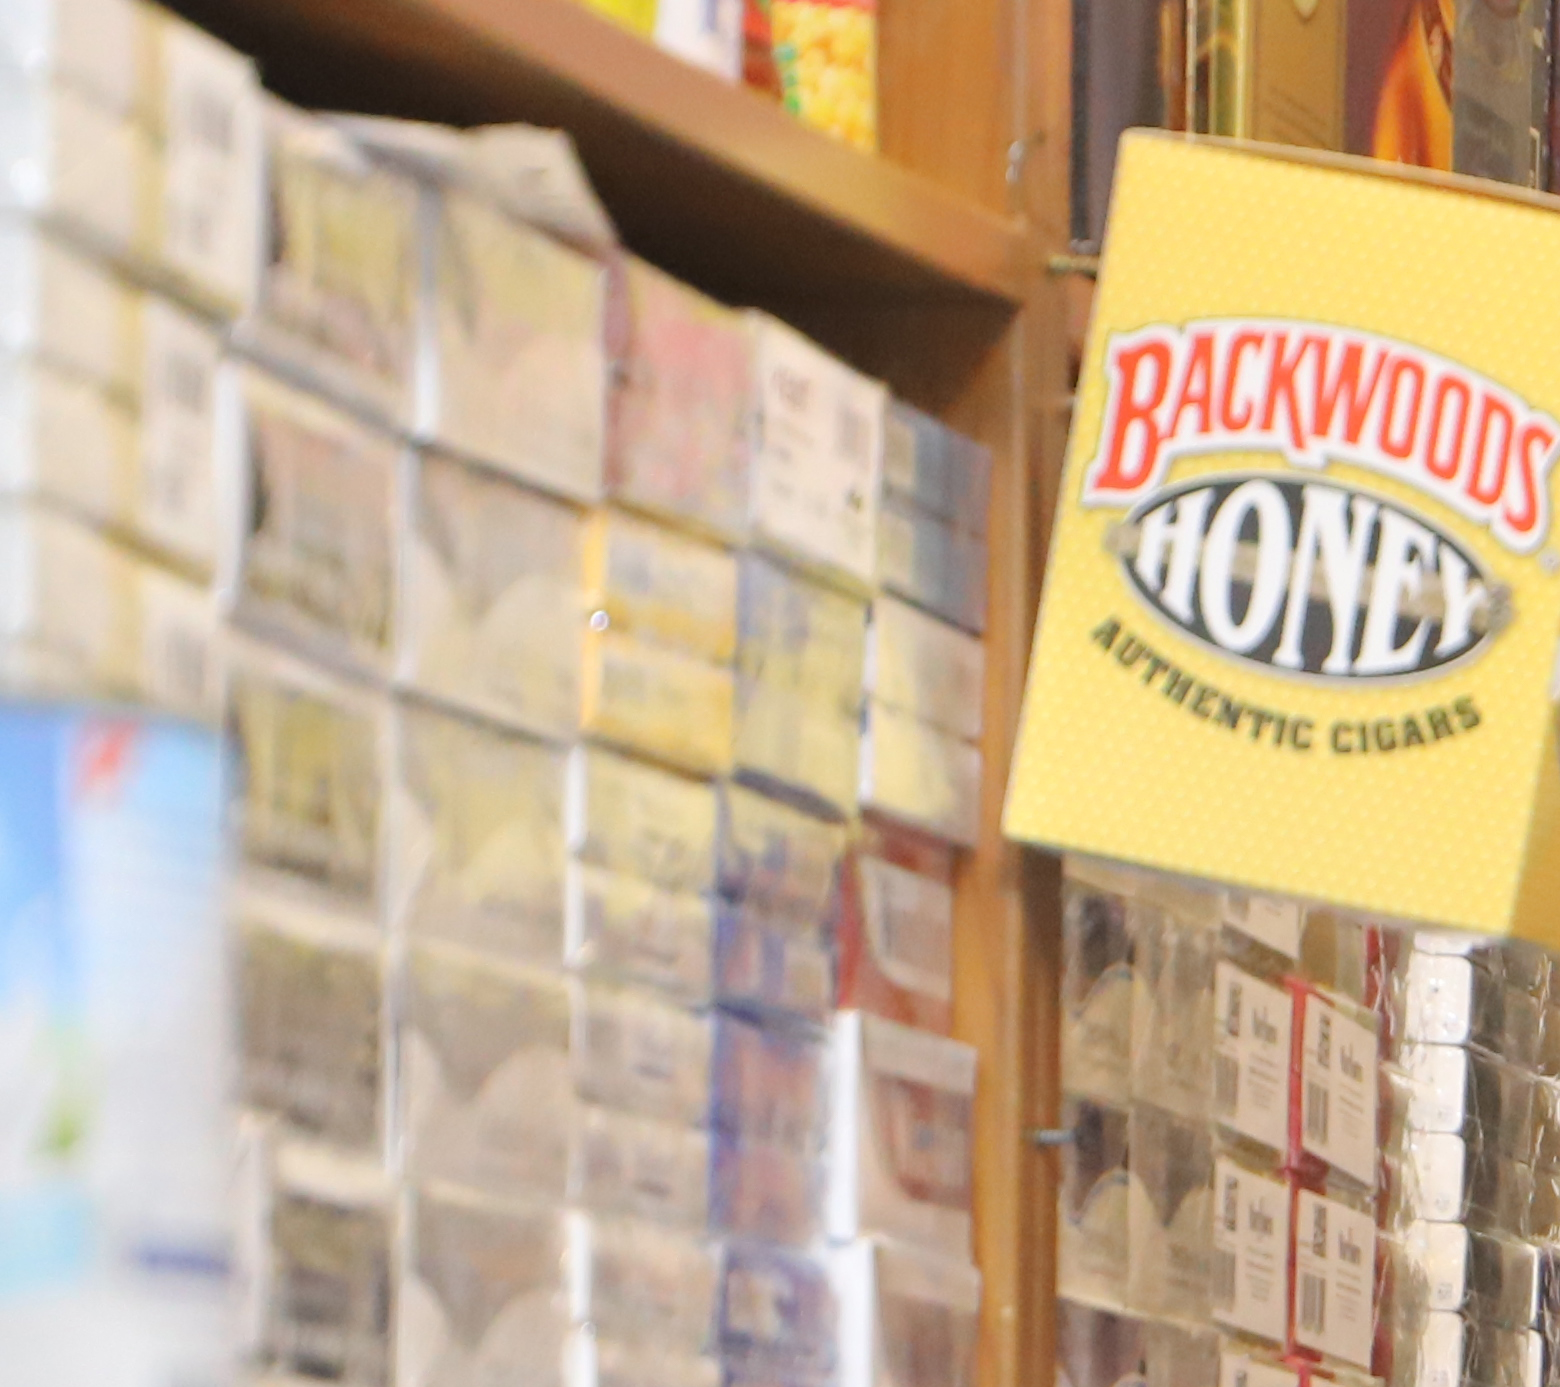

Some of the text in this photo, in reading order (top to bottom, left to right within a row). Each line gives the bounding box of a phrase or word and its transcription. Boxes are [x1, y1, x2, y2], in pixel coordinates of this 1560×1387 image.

[1093, 325, 1556, 534] BACKWOODS
[1133, 478, 1494, 676] HONEY
[1091, 616, 1483, 754] AUTHENTIC CIGARS
